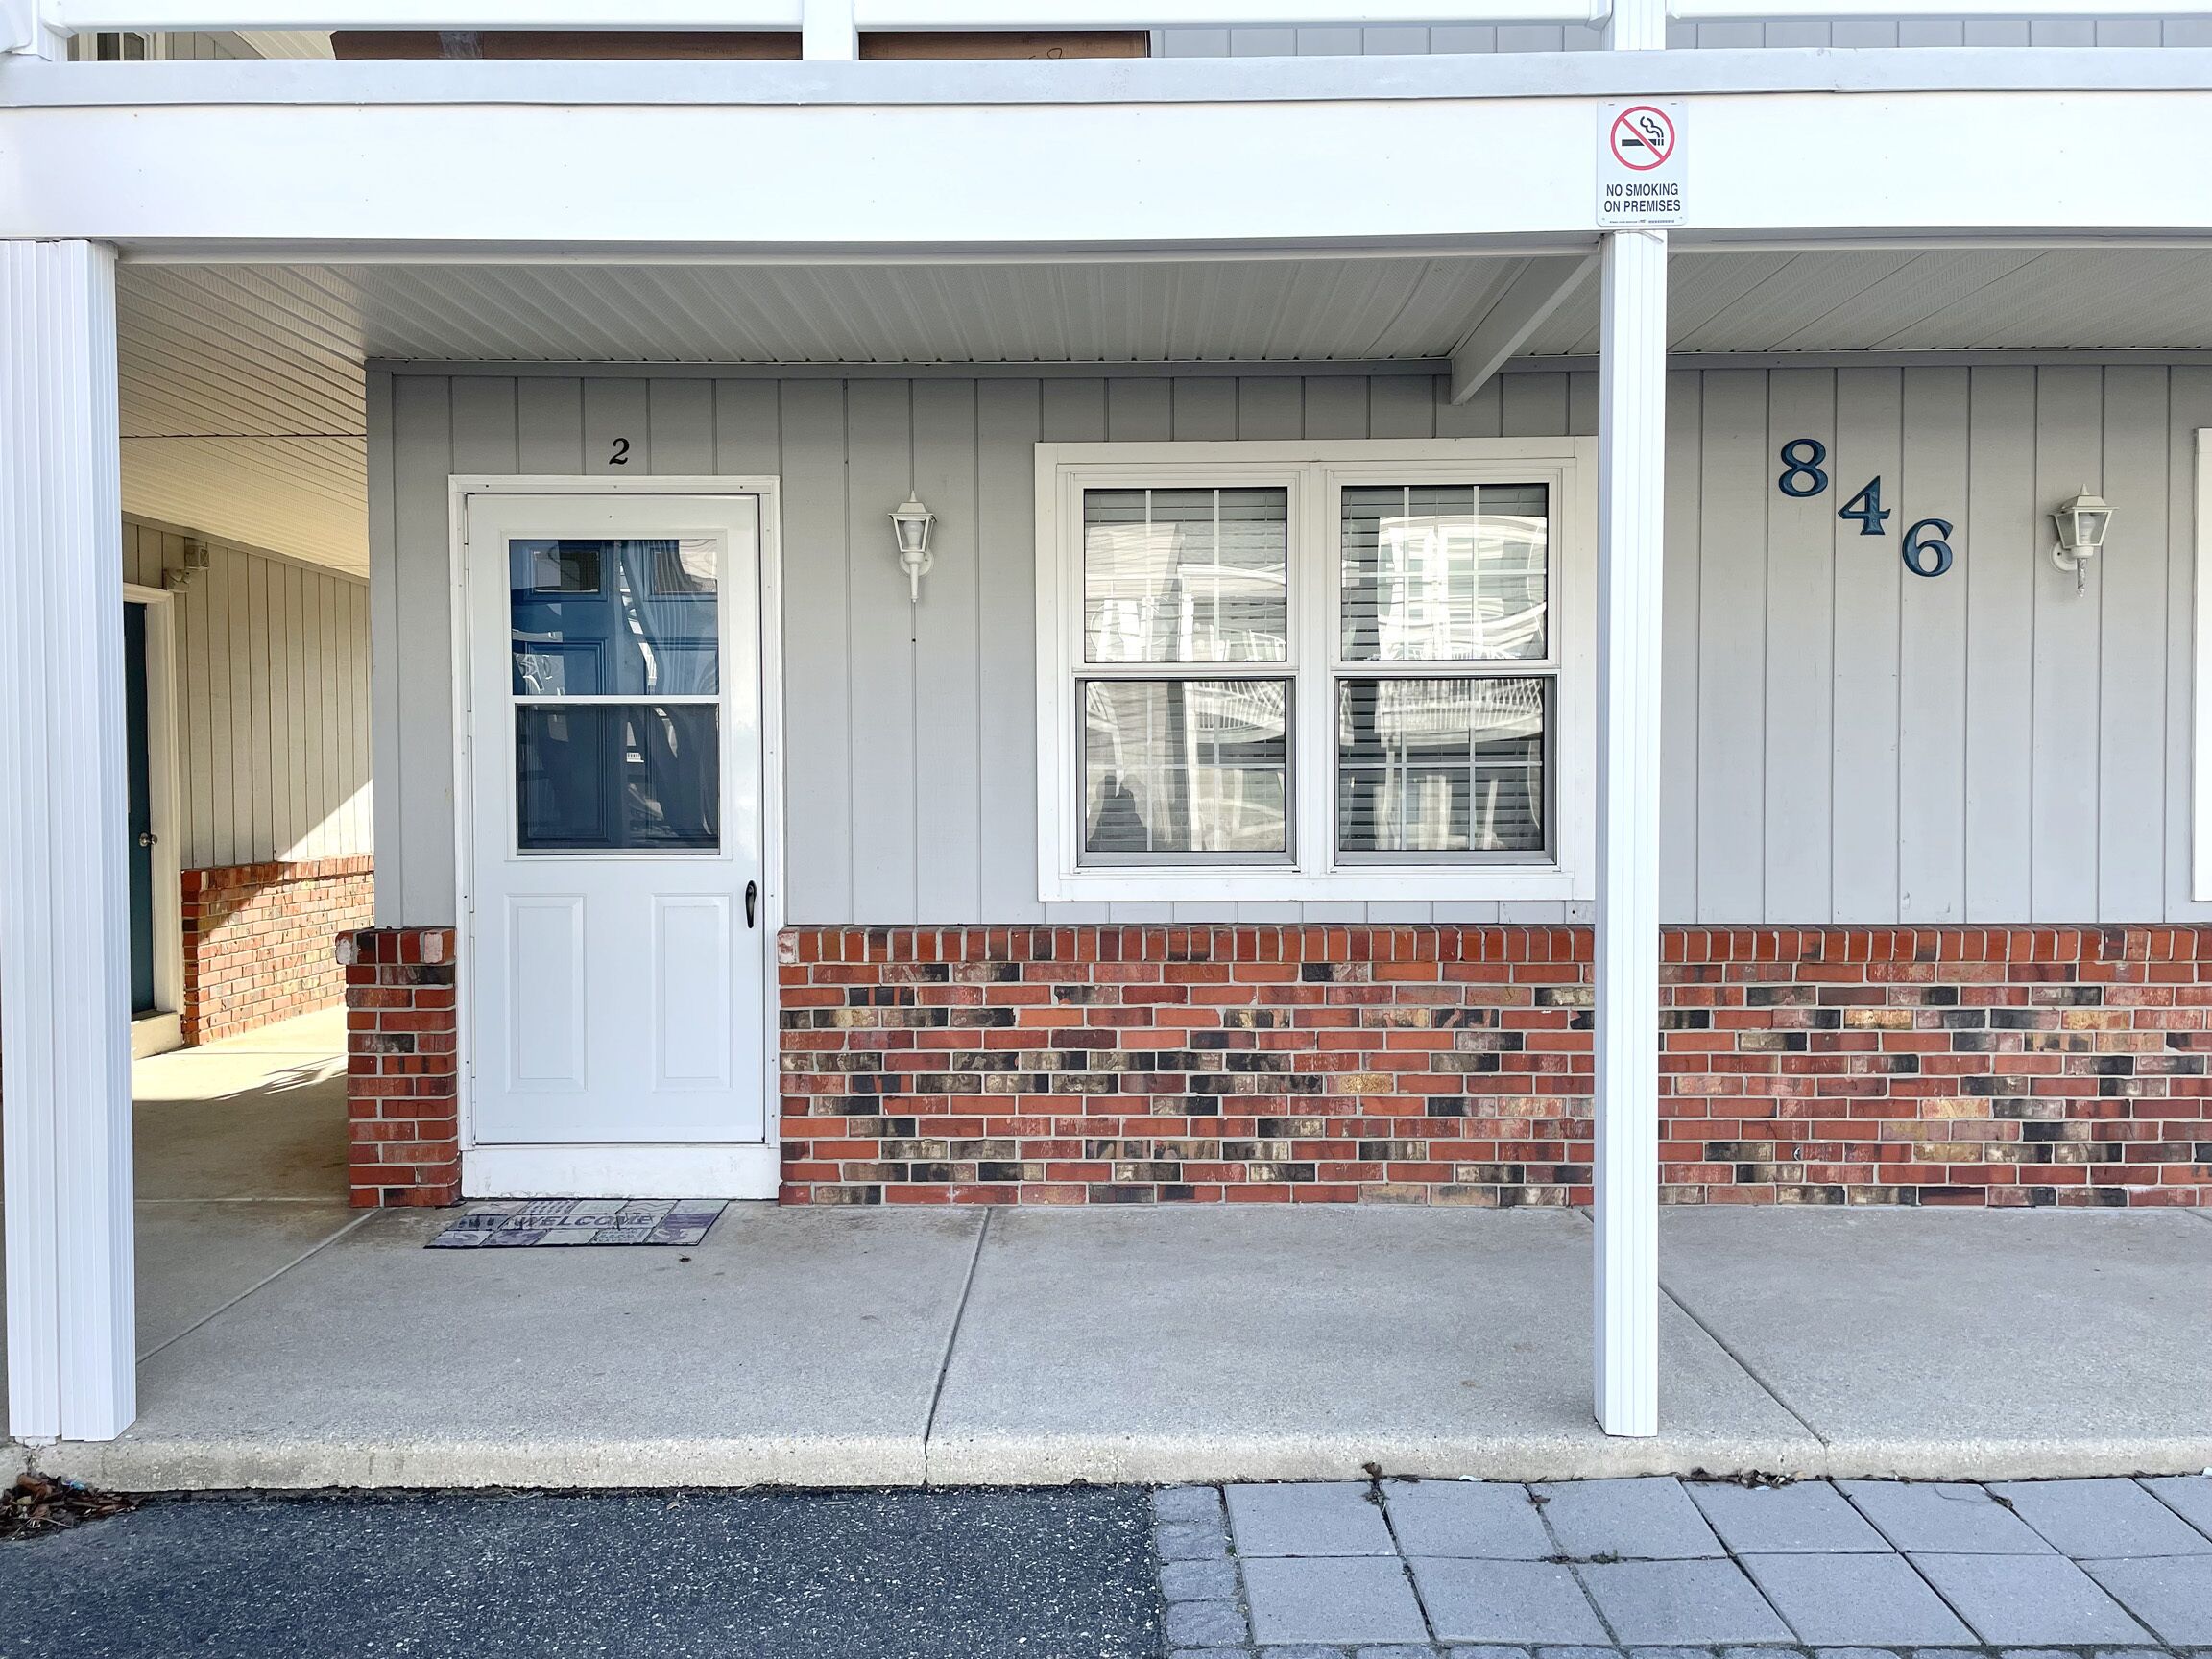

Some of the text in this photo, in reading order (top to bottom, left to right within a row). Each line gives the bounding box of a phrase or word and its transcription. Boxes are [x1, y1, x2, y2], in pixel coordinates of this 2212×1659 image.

[1606, 182, 1678, 197] NO SMOKING
[1603, 199, 1681, 213] ON PREMISES
[608, 437, 630, 465] 2
[1778, 438, 1954, 577] 846
[514, 1214, 653, 1226] WELCOME
